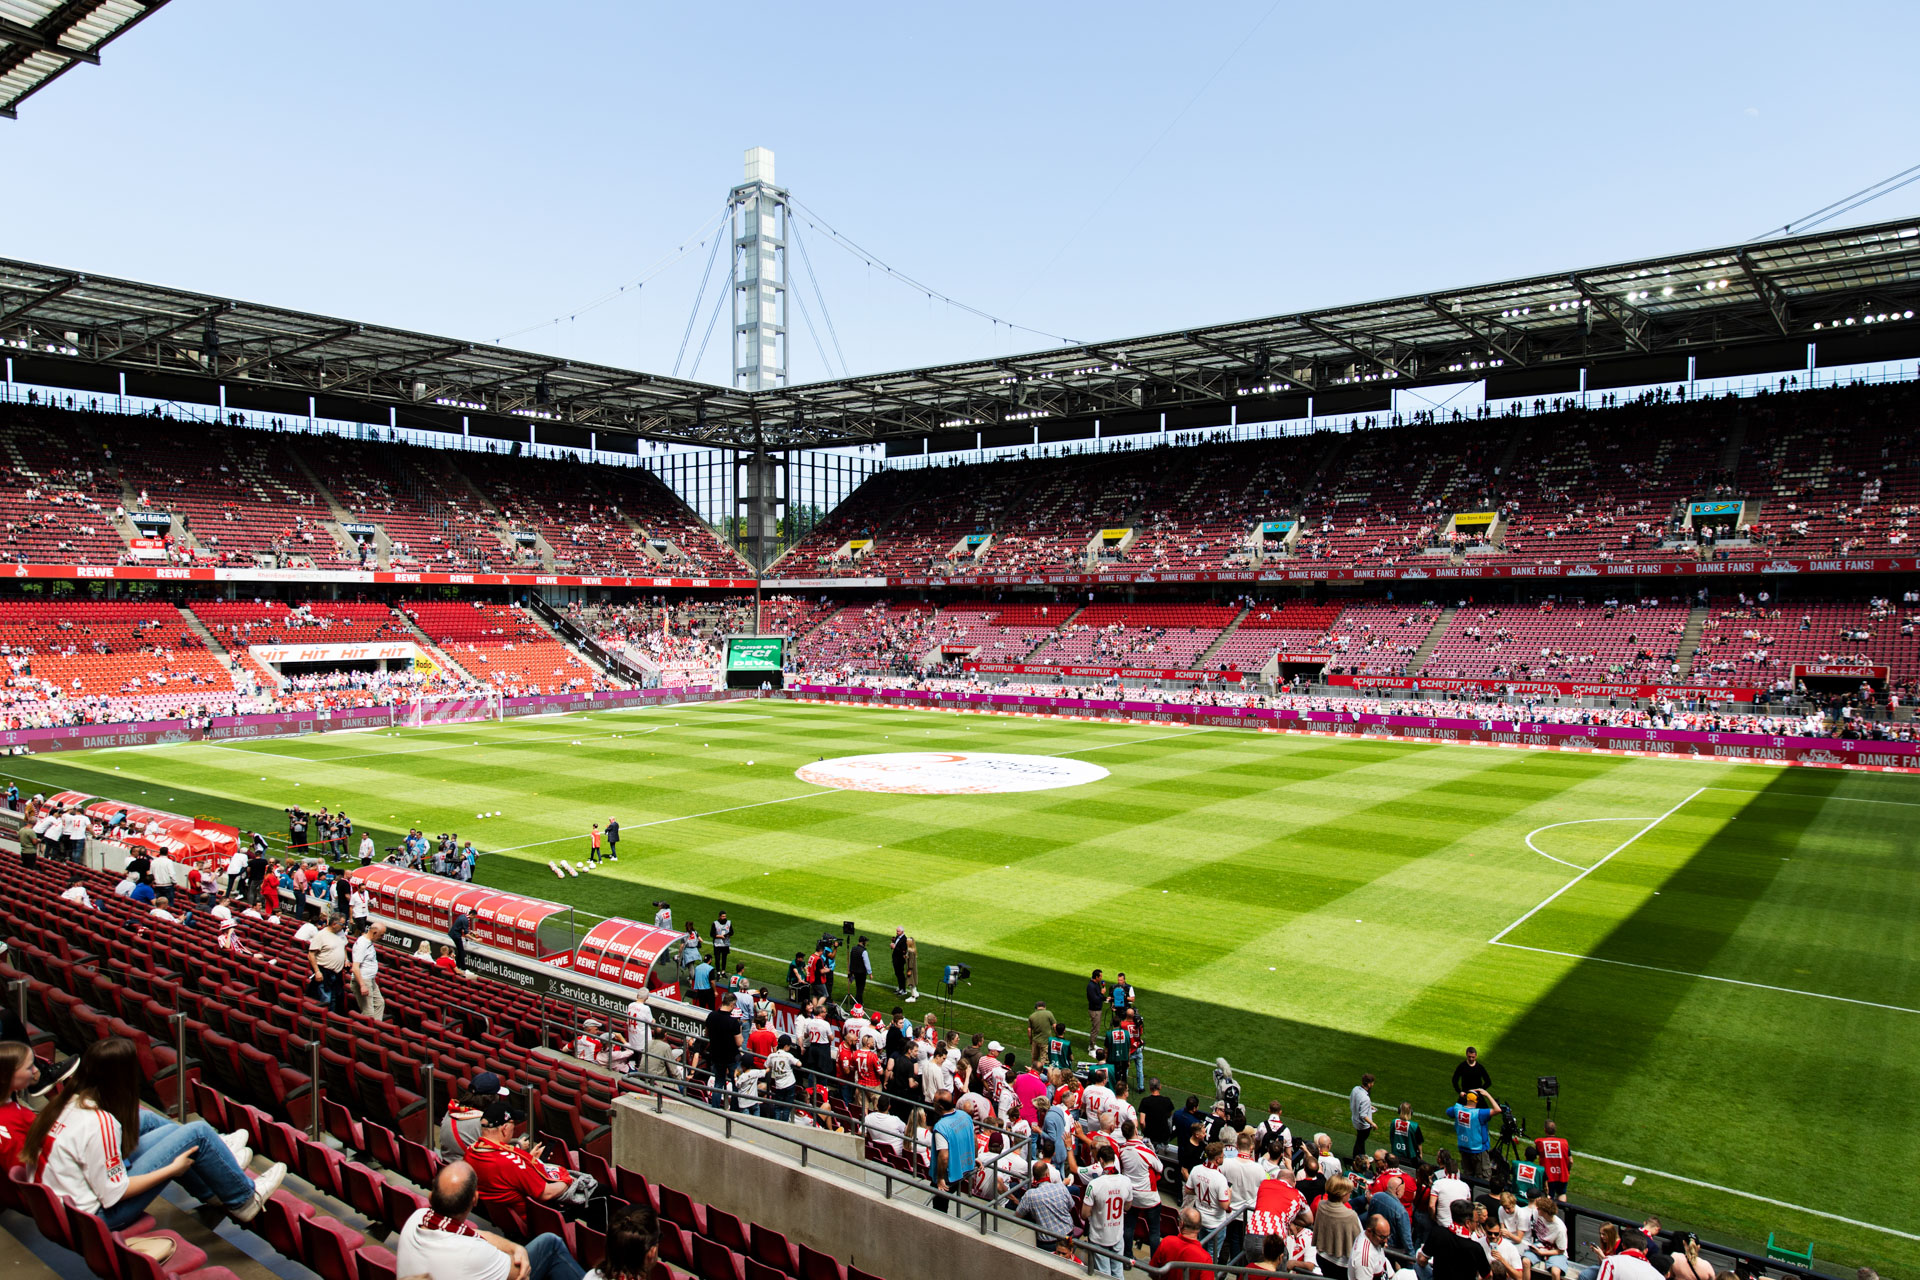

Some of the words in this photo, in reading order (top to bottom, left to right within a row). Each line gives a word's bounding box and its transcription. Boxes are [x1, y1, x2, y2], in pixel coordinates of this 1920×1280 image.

[1608, 565, 1634, 574] DANKE
[1637, 565, 1662, 573] FANS!
[1696, 563, 1725, 572] DANKE
[1728, 563, 1754, 572] FANS!
[1810, 561, 1842, 570] DANKE
[1845, 560, 1874, 570] FANS!
[77, 568, 114, 577] REWE
[157, 569, 190, 578] REWE
[1436, 569, 1458, 577] DANKE
[1461, 568, 1482, 576] FANS!
[1511, 567, 1536, 575] DANKE
[1538, 567, 1560, 575] FANS!
[300, 651, 329, 659] HIT
[341, 649, 369, 658] HIT
[379, 648, 406, 656] HIT
[1353, 678, 1405, 686] SCHÜTTFLIX
[570, 702, 587, 710] DANKE
[590, 700, 604, 708] FANS!
[1079, 708, 1096, 716] FANS!
[1132, 712, 1151, 720] DANKE
[1154, 713, 1173, 721] FANS!
[342, 718, 366, 728] DANKE
[368, 716, 389, 725] FANS!
[1212, 715, 1241, 726] SPÜRBAR
[1243, 718, 1269, 728] ANDERS.
[1307, 721, 1331, 731] DANKE
[1334, 723, 1356, 733] FANS!
[210, 728, 231, 738] ANKE
[1404, 727, 1431, 737] DANKE
[1433, 729, 1458, 739] FANS!
[1492, 732, 1520, 743] DANKE
[1524, 734, 1550, 744] FANS!
[83, 736, 115, 748] DANKE
[119, 734, 146, 745] FANS!
[1609, 739, 1641, 750] DANKE
[1645, 741, 1674, 752] FANS!
[1715, 745, 1750, 757] DANKE
[1754, 747, 1786, 759] FANS!
[1859, 753, 1898, 766] DANKE
[73, 820, 80, 828] 14
[366, 880, 380, 890] REWE
[382, 885, 397, 894] REWE
[399, 889, 415, 899] REWE
[416, 893, 432, 904] REWE
[382, 902, 395, 913] REWE
[434, 898, 450, 908] REWE
[399, 908, 413, 918] REWE
[416, 912, 431, 923] REWE
[478, 908, 494, 919] REWE
[434, 917, 448, 928] REWE
[497, 914, 515, 925] REWE
[518, 919, 536, 930] REWE
[497, 934, 513, 945] REWE
[585, 936, 608, 947] REWE
[518, 940, 534, 951] REWE
[609, 942, 631, 954] REWE
[633, 948, 656, 960] REWE
[576, 956, 597, 970] REWE
[500, 964, 534, 985] Lösungen
[600, 963, 620, 976] REWE
[624, 970, 644, 984] REWE
[560, 983, 590, 1002] Service
[591, 994, 598, 1004] &
[809, 1031, 820, 1043] 22
[773, 1061, 786, 1075] 42
[856, 1058, 868, 1072] 14
[1089, 1096, 1101, 1112] 14
[1197, 1183, 1210, 1205] 14
[1106, 1197, 1123, 1220] 19
